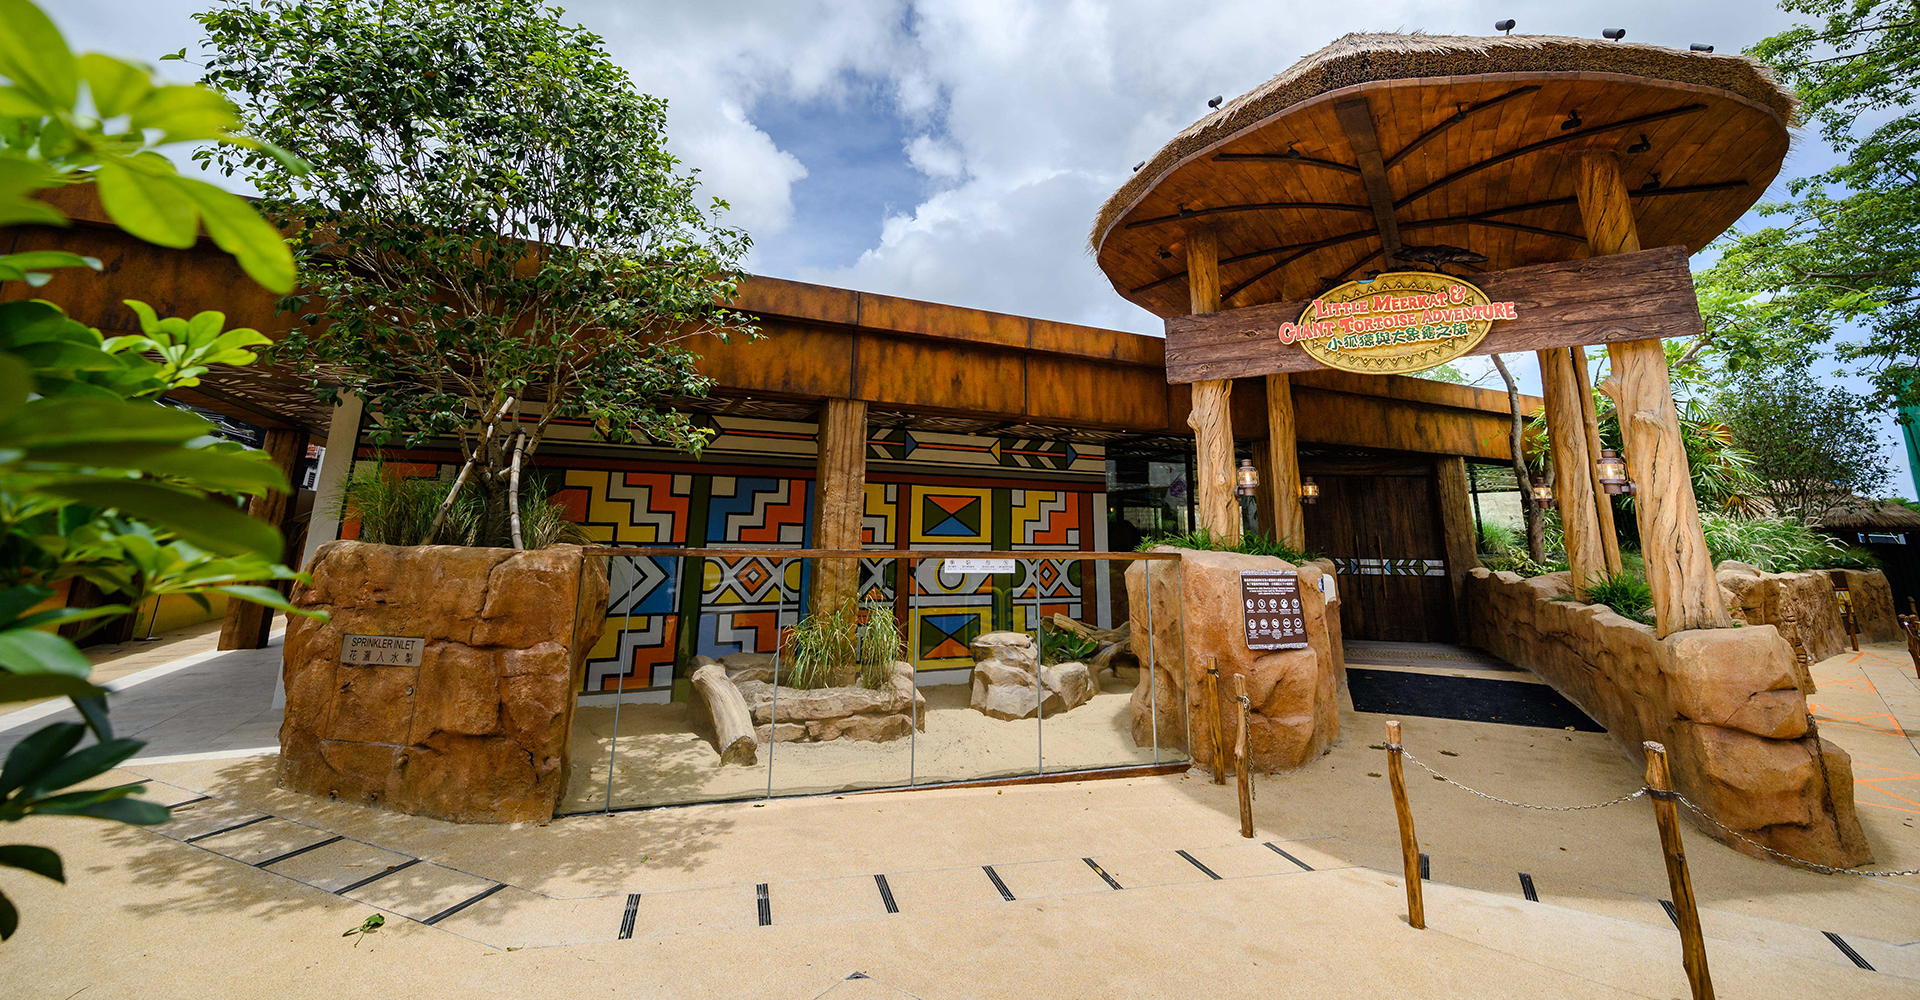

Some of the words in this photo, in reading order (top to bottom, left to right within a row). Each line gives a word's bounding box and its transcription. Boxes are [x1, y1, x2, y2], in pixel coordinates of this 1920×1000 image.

[1449, 284, 1467, 304] &
[351, 637, 392, 649] SPRINKLER
[393, 640, 416, 650] INLET
